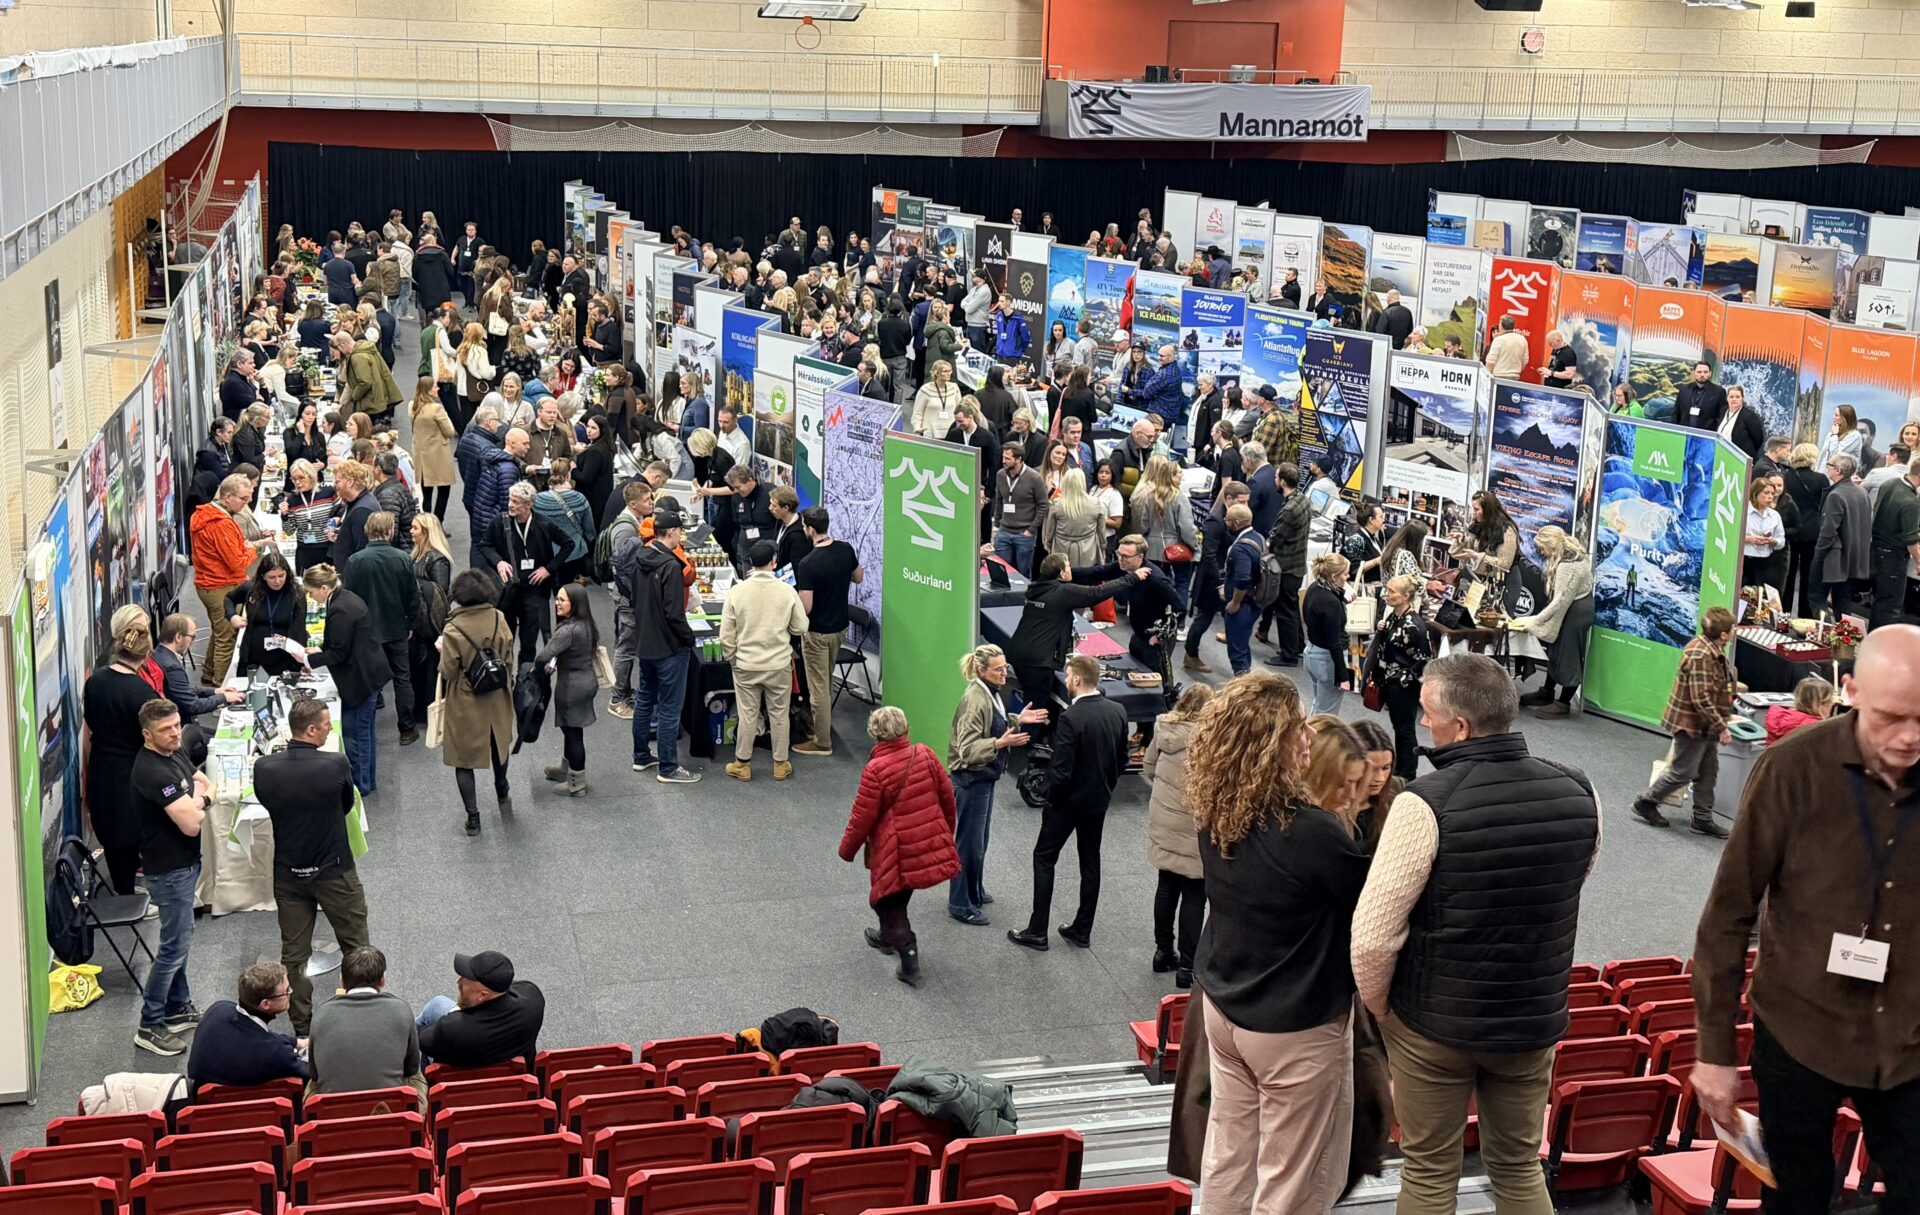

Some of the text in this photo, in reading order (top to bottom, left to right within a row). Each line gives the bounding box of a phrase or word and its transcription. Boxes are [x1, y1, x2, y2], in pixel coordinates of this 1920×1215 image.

[1219, 112, 1363, 137] Mannamót
[1811, 226, 1831, 235] Sailing
[993, 258, 1008, 266] SHOW
[1011, 298, 1043, 315] MIÐJAN
[1193, 299, 1234, 313] JOURNEY
[1203, 294, 1224, 302] GLACIER
[1139, 310, 1180, 324] ICE FLOATING
[1263, 340, 1301, 358] Atlantsflug
[1851, 346, 1891, 358] BLUE LAGOON
[1303, 367, 1370, 385] VATNAJÖKULL
[1400, 366, 1472, 387] HEPPA HORN
[1494, 443, 1522, 455] VIKING
[1523, 449, 1552, 461] ESCAPE
[1553, 455, 1575, 466] ROOM
[1630, 543, 1670, 564] Purity
[902, 566, 952, 591] Suðurland
